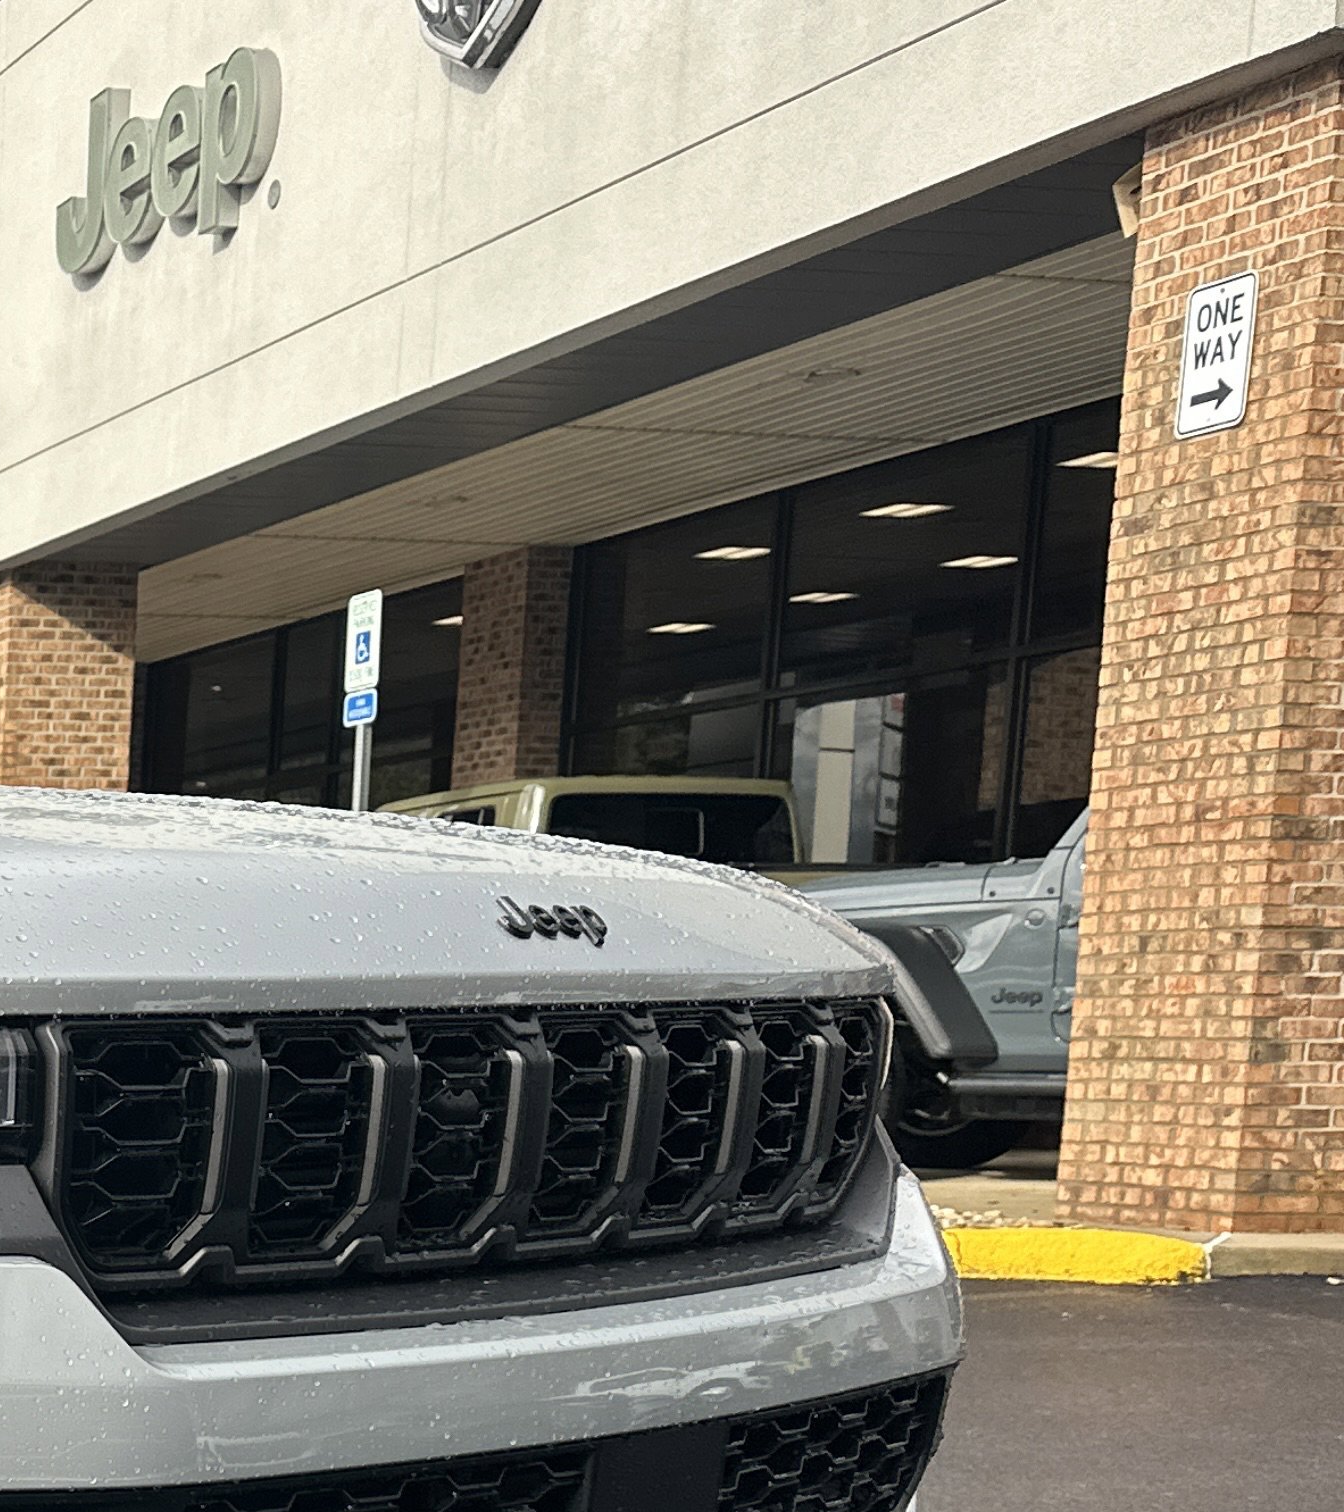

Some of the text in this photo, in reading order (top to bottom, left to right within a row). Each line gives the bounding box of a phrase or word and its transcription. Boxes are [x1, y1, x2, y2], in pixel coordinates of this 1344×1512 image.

[55, 47, 282, 274] Jeep
[1197, 292, 1245, 333] ONE
[1193, 329, 1243, 370] WAY
[495, 896, 608, 948] Jeep
[991, 987, 1043, 1008] Jeep
